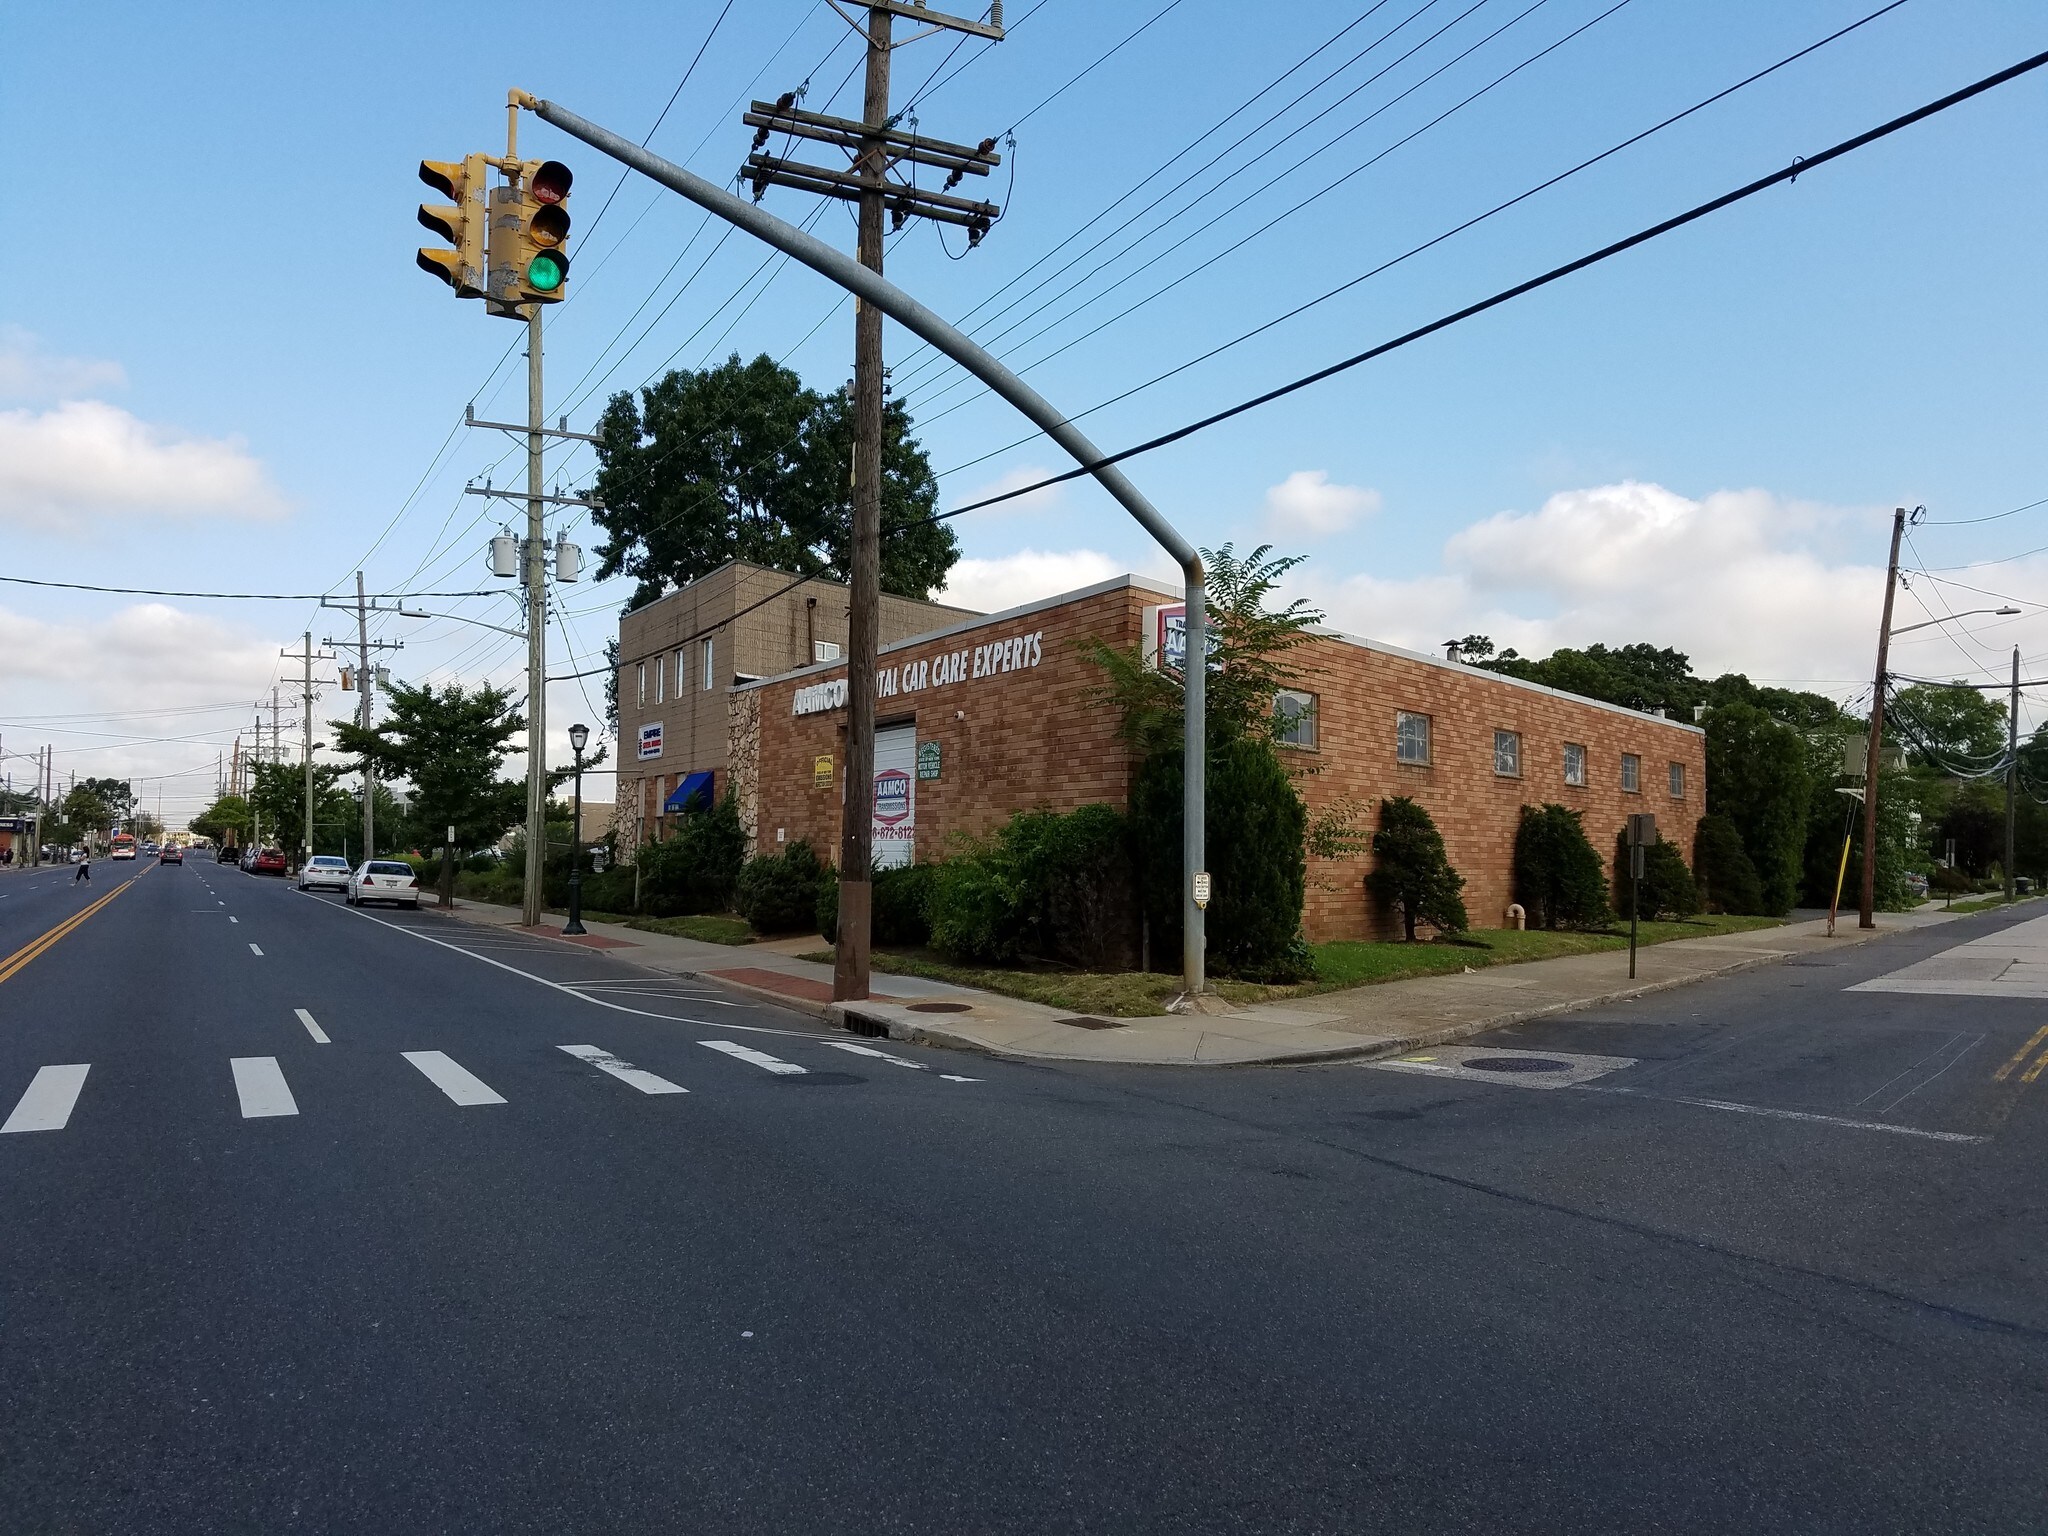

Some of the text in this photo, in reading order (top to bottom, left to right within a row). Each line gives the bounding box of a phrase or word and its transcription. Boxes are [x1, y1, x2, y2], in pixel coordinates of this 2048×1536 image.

[792, 631, 1043, 715] AAMCO TAL CAR CARE EXPERTS
[877, 779, 906, 796] AAMCO
